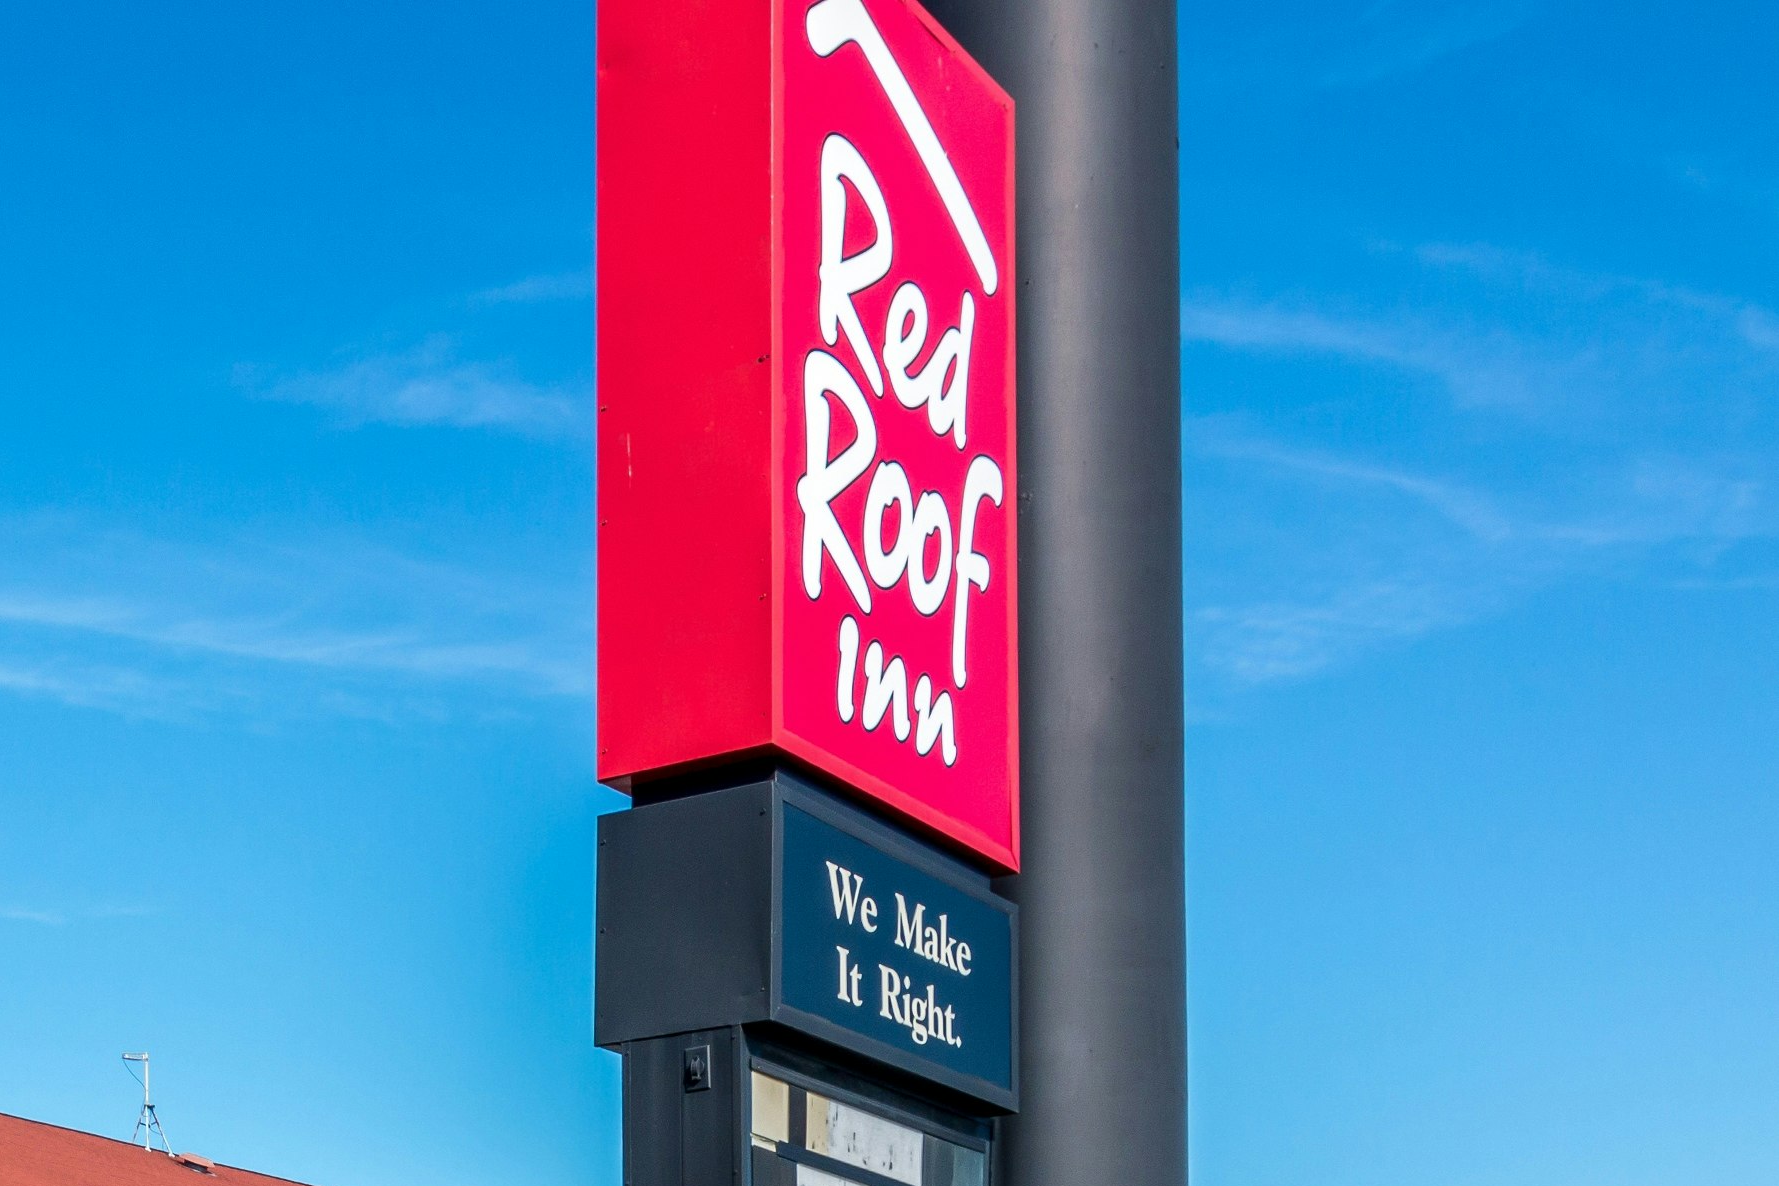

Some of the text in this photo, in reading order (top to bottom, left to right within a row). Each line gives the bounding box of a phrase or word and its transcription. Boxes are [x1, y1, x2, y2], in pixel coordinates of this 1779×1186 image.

[818, 132, 976, 452] Red
[796, 348, 1004, 692] Roof
[826, 861, 972, 976] We Make
[836, 946, 964, 1048] It Right.
